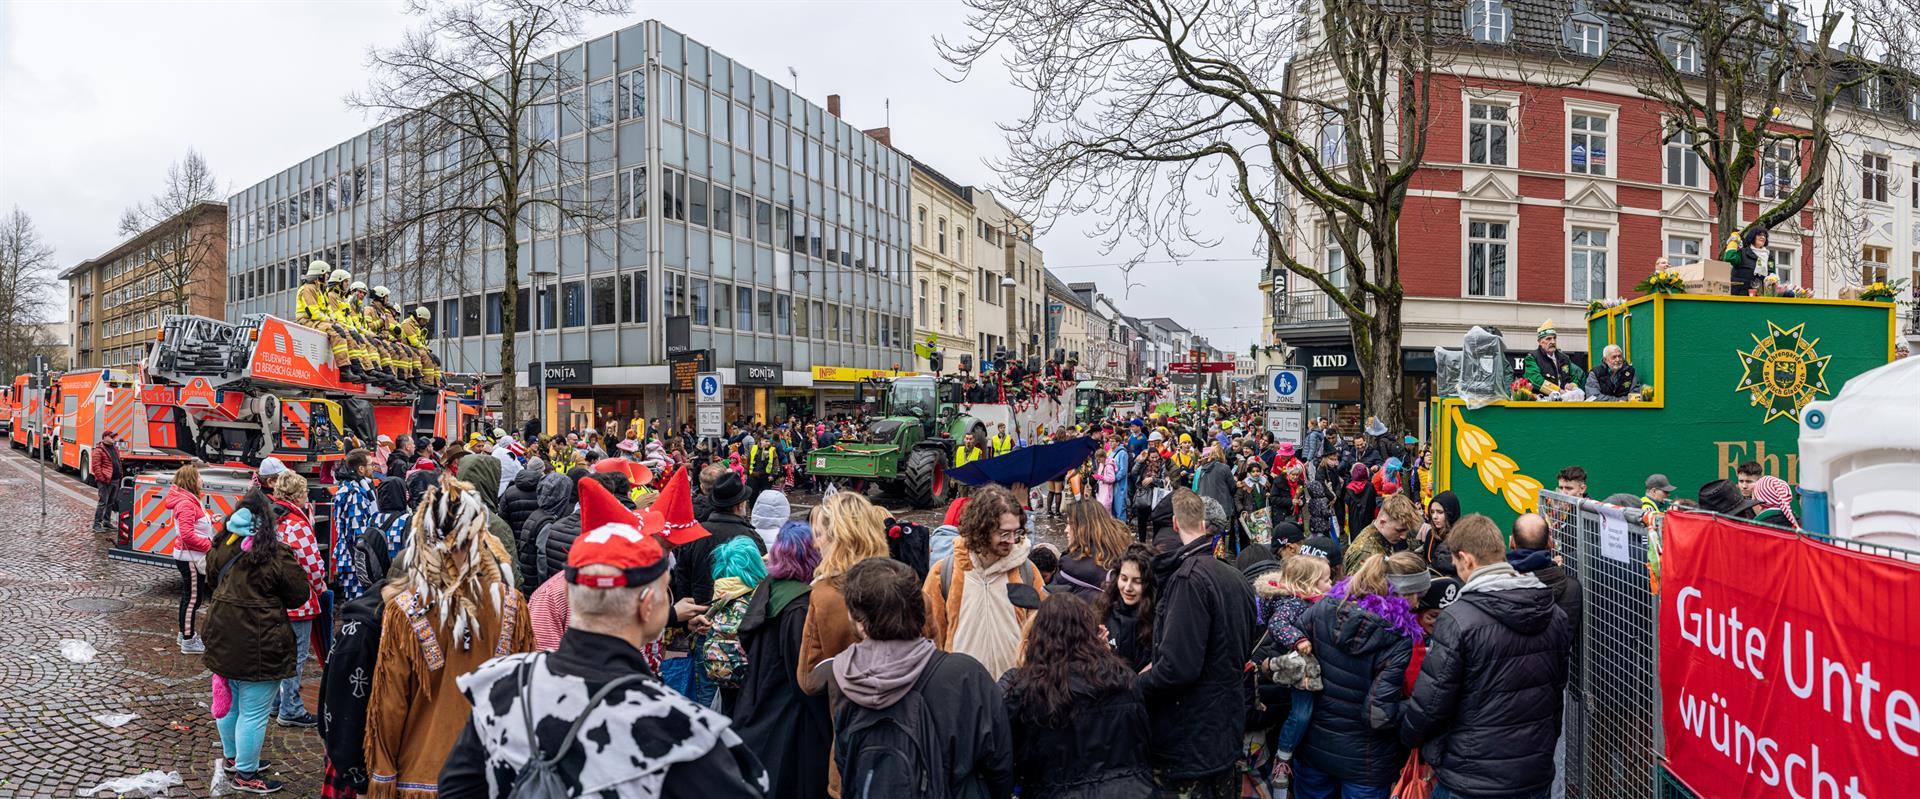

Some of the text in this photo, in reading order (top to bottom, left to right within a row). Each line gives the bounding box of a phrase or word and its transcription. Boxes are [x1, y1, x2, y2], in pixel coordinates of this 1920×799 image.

[262, 351, 292, 366] FEUERWEHR
[1312, 354, 1348, 368] KIND
[1768, 351, 1802, 365] Ehrengarde
[261, 362, 311, 380] BERGISCH GLADBACH
[749, 366, 775, 381] BONITA
[1763, 371, 1806, 396] Bergisch Gladbach
[154, 391, 173, 403] 112
[157, 424, 169, 447] 1
[1299, 544, 1328, 558] POLICE
[1676, 586, 1920, 757] Gute Unte
